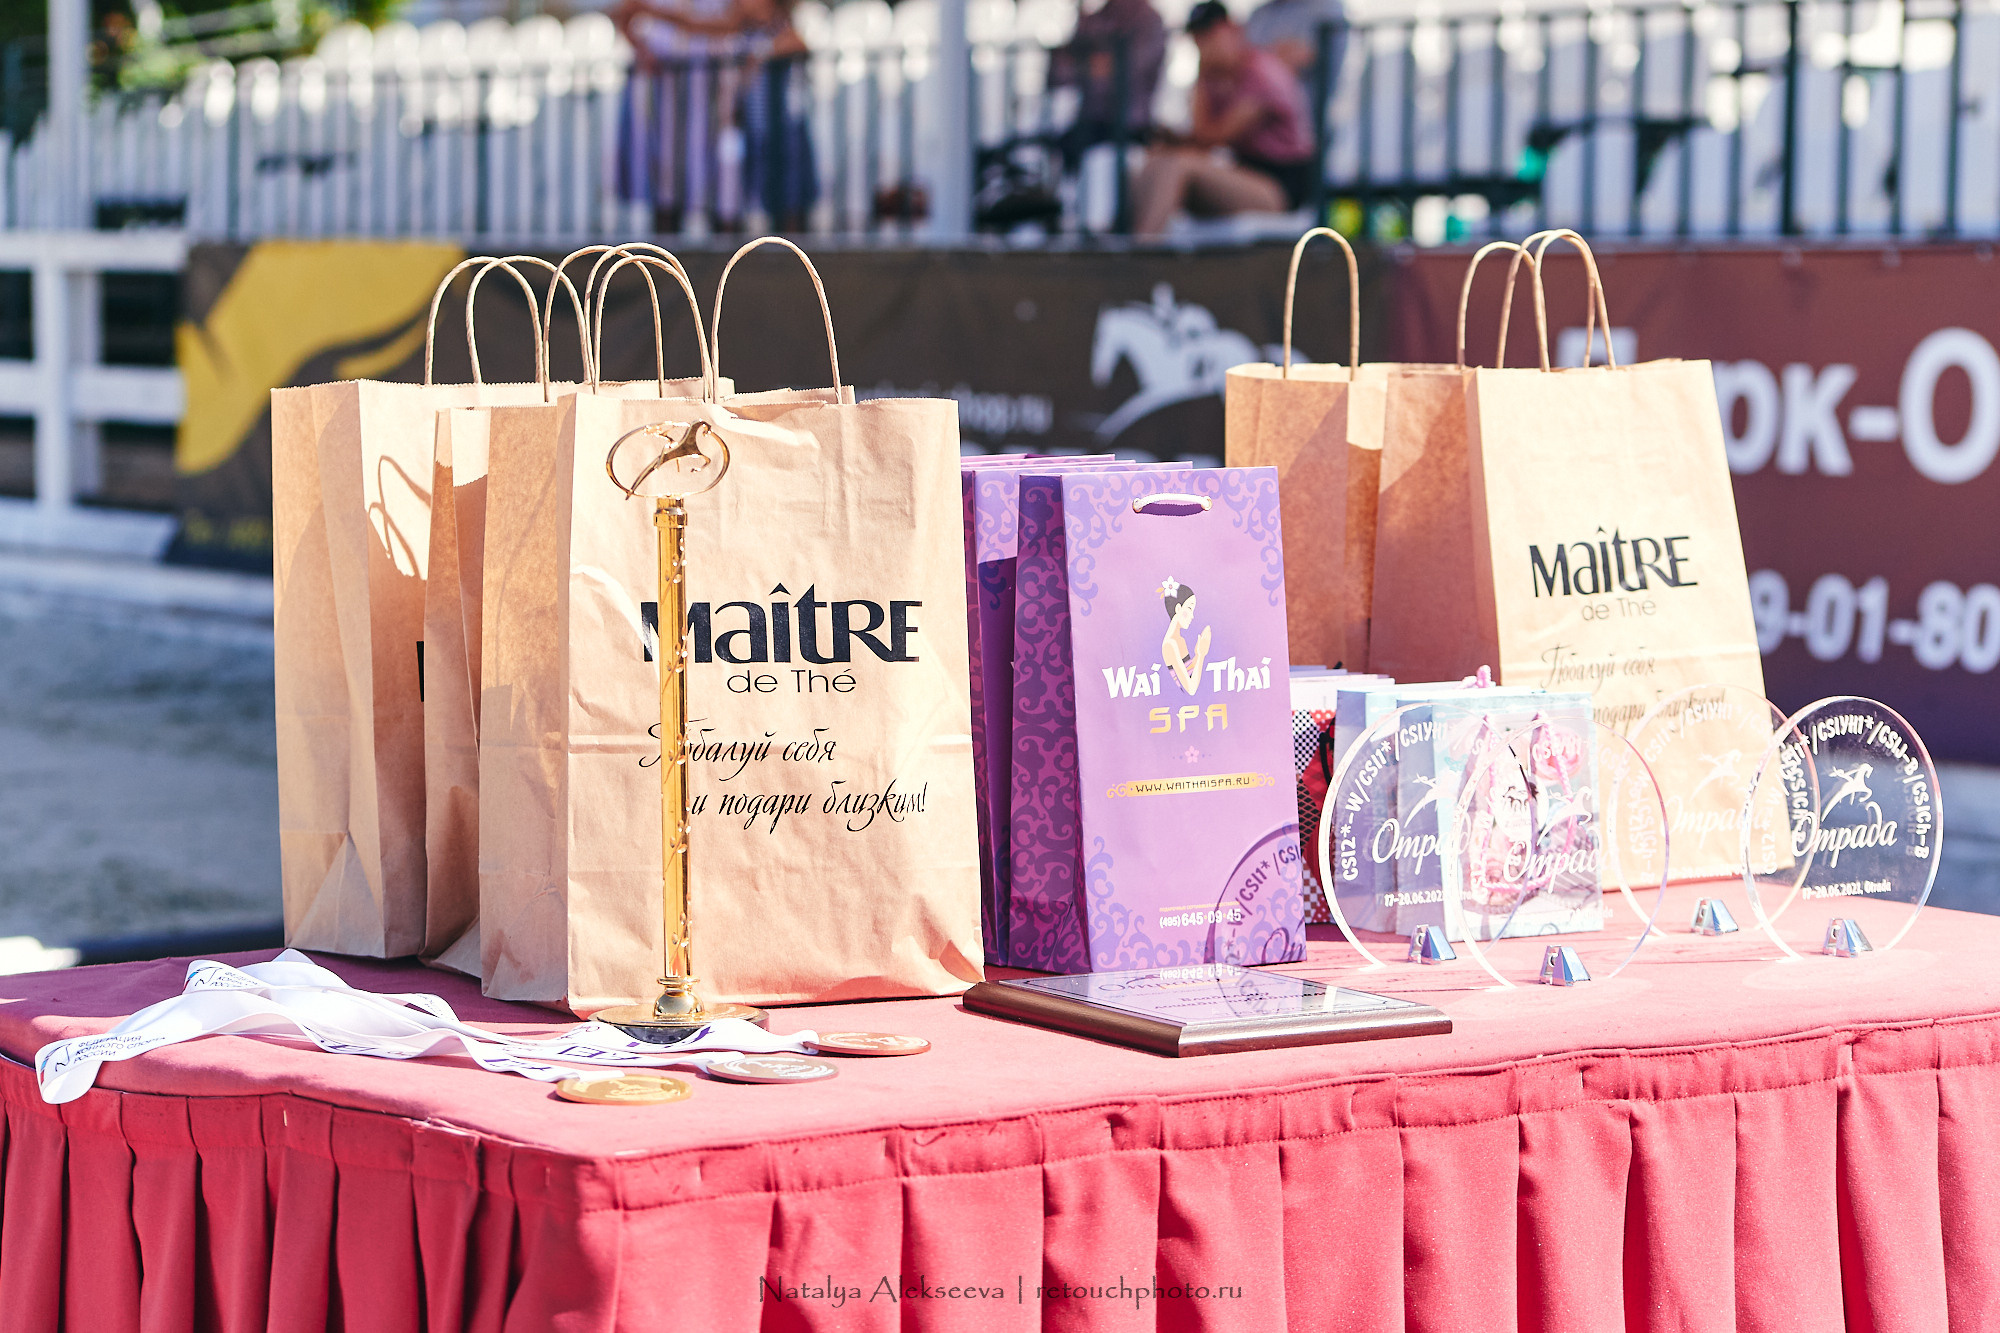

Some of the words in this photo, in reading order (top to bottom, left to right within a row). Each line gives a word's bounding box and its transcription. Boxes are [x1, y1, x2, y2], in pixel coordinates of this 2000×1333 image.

[1581, 598, 1610, 621] de
[726, 669, 778, 693] de
[791, 668, 857, 693] Thé
[1150, 704, 1228, 734] SPA
[782, 727, 837, 763] себя
[691, 793, 708, 815] и
[718, 793, 812, 835] подари
[822, 779, 928, 832] близким!
